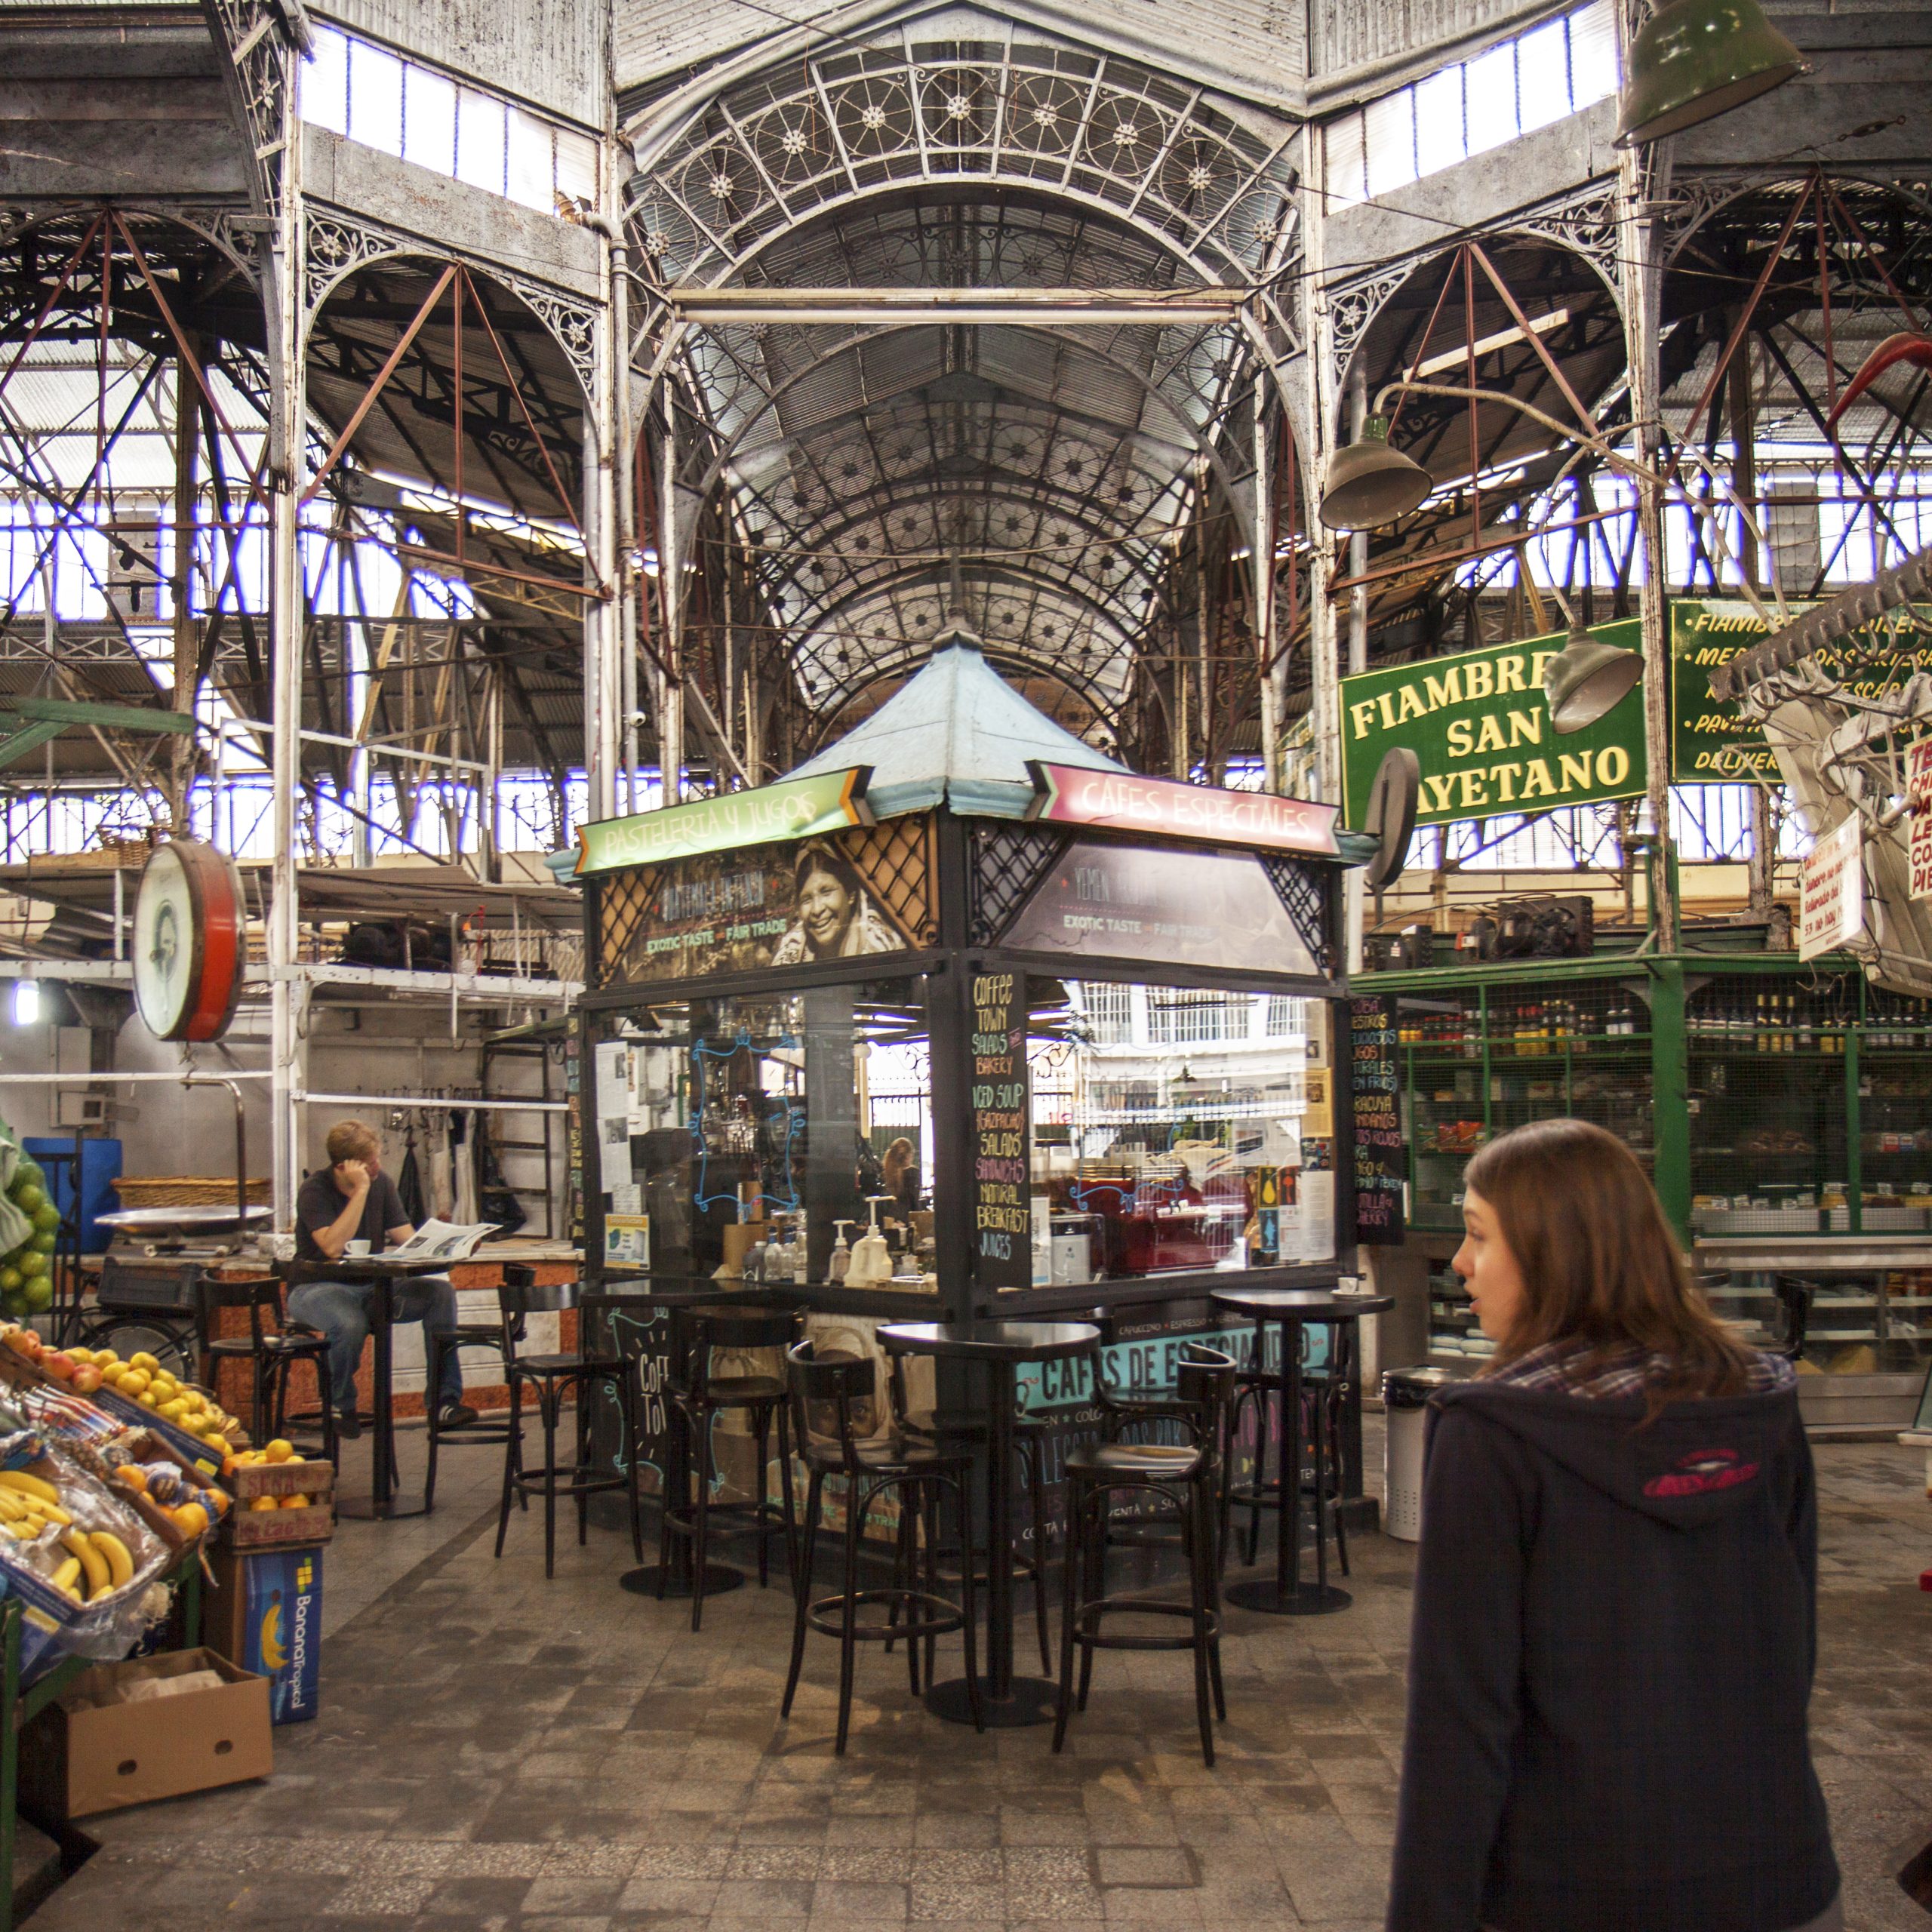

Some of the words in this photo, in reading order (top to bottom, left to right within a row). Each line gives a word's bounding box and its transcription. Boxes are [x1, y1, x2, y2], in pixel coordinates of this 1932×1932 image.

[1349, 651, 1639, 740] FIAMBRE
[1447, 706, 1542, 758] SAN
[1416, 746, 1630, 815] AYETANO
[1081, 778, 1161, 820] CAFES
[1174, 794, 1311, 837] ESPECIALES
[647, 936, 680, 954] EXOTIC
[681, 930, 715, 946] TASTE
[725, 923, 750, 941] FAIR
[750, 918, 787, 937] TRADE
[1063, 915, 1104, 931] EXOTIC
[1106, 918, 1142, 934] TASTE
[975, 1007, 1007, 1032] TOWN
[971, 1033, 1008, 1055] SALADS
[976, 1057, 1014, 1075] BAKERY
[972, 1084, 995, 1109] ICED
[995, 1083, 1024, 1109] SOUP
[980, 1133, 1023, 1157] SALADS
[977, 1205, 1029, 1234] BREAKFAST
[1042, 1349, 1121, 1401] CAFS
[1129, 1345, 1156, 1387] DE
[288, 1594, 312, 1710] BananaTropical
